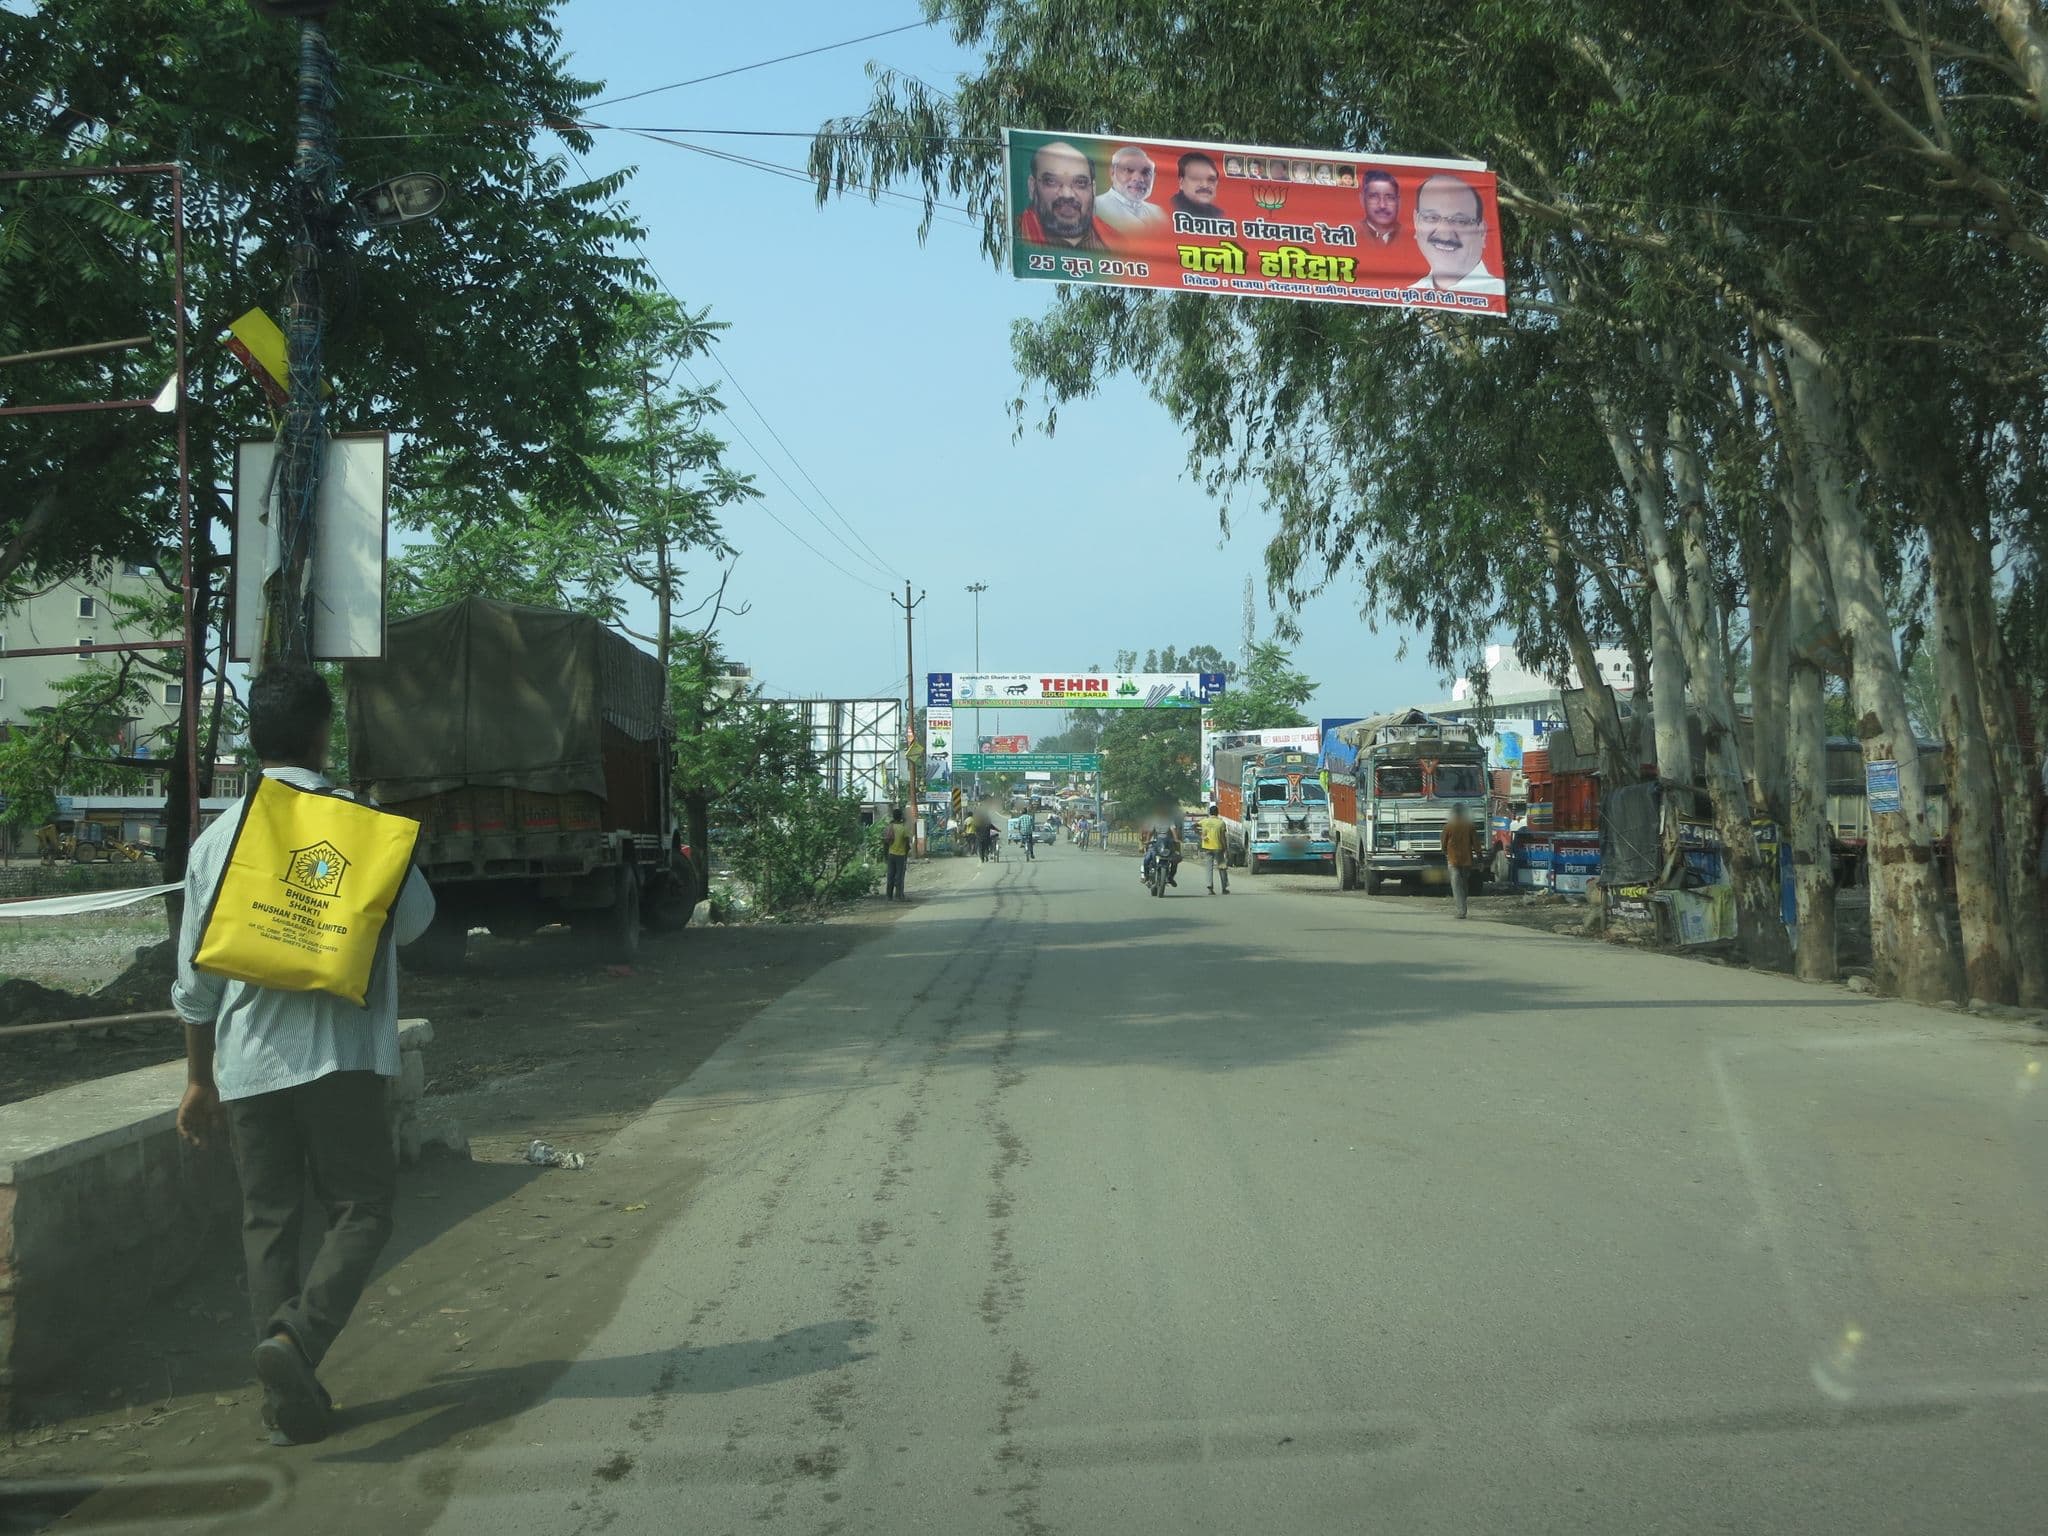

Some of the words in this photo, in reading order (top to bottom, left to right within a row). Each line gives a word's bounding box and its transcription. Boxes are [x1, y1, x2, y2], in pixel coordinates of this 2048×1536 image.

[1173, 211, 1237, 237] विशाल
[1243, 218, 1315, 243] शंखनाद
[1029, 255, 1055, 271] 25
[1061, 256, 1093, 278] जून
[1099, 260, 1149, 277] 2016
[1177, 241, 1247, 276] चलो
[1259, 246, 1358, 283] हरिद्वार
[1182, 273, 1219, 288] निवेदक
[1231, 279, 1264, 291] भाजपा
[1314, 284, 1348, 297] ग्रामीण
[1401, 287, 1420, 304] मुनि
[1422, 290, 1437, 303] की
[1040, 678, 1108, 692] TEHRI
[285, 888, 329, 909] BHUSHAN
[289, 900, 321, 917] SHAKTI
[252, 901, 291, 918] BHUSHAN
[291, 913, 317, 928] STEEL
[318, 920, 348, 935] LIMITED
